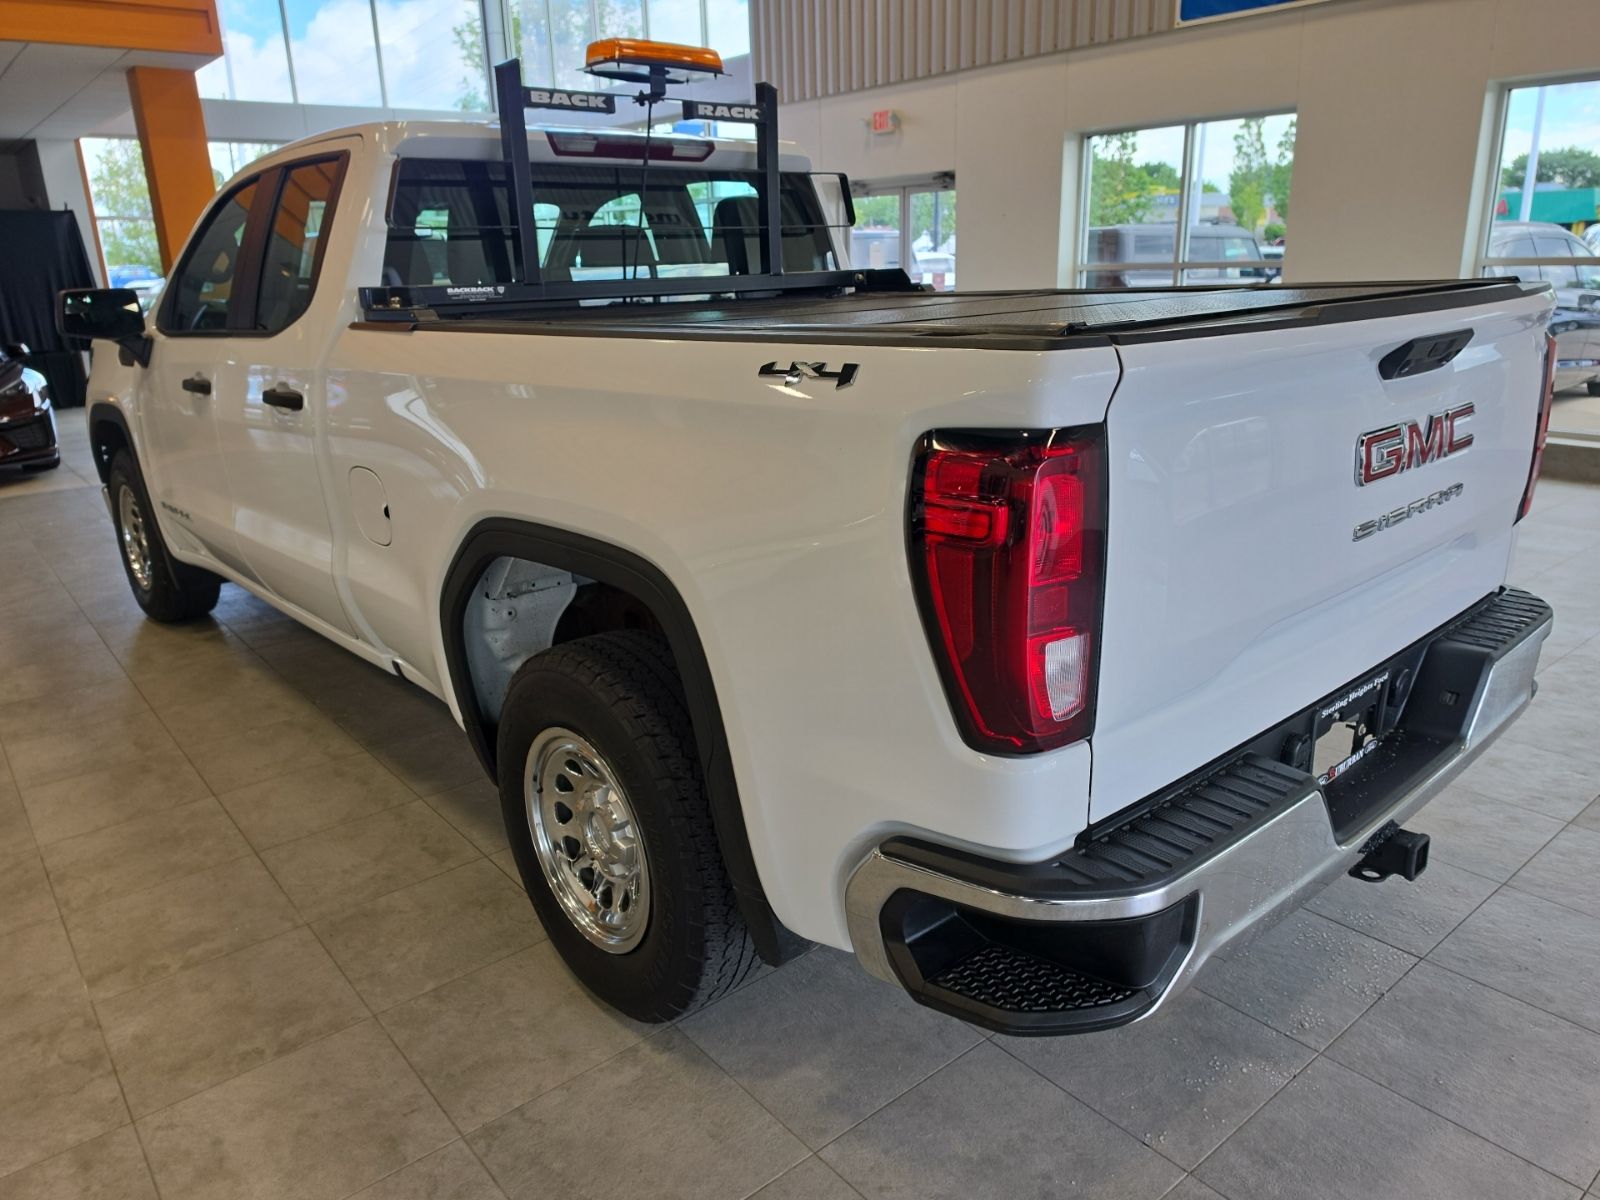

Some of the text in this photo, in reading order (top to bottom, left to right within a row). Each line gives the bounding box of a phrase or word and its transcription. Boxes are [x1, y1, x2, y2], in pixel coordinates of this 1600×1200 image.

[530, 90, 760, 120] BACK RACK
[1354, 402, 1476, 487] GMC
[1352, 482, 1464, 542] SIERRA
[1321, 672, 1389, 719] Sterling Heights Ford
